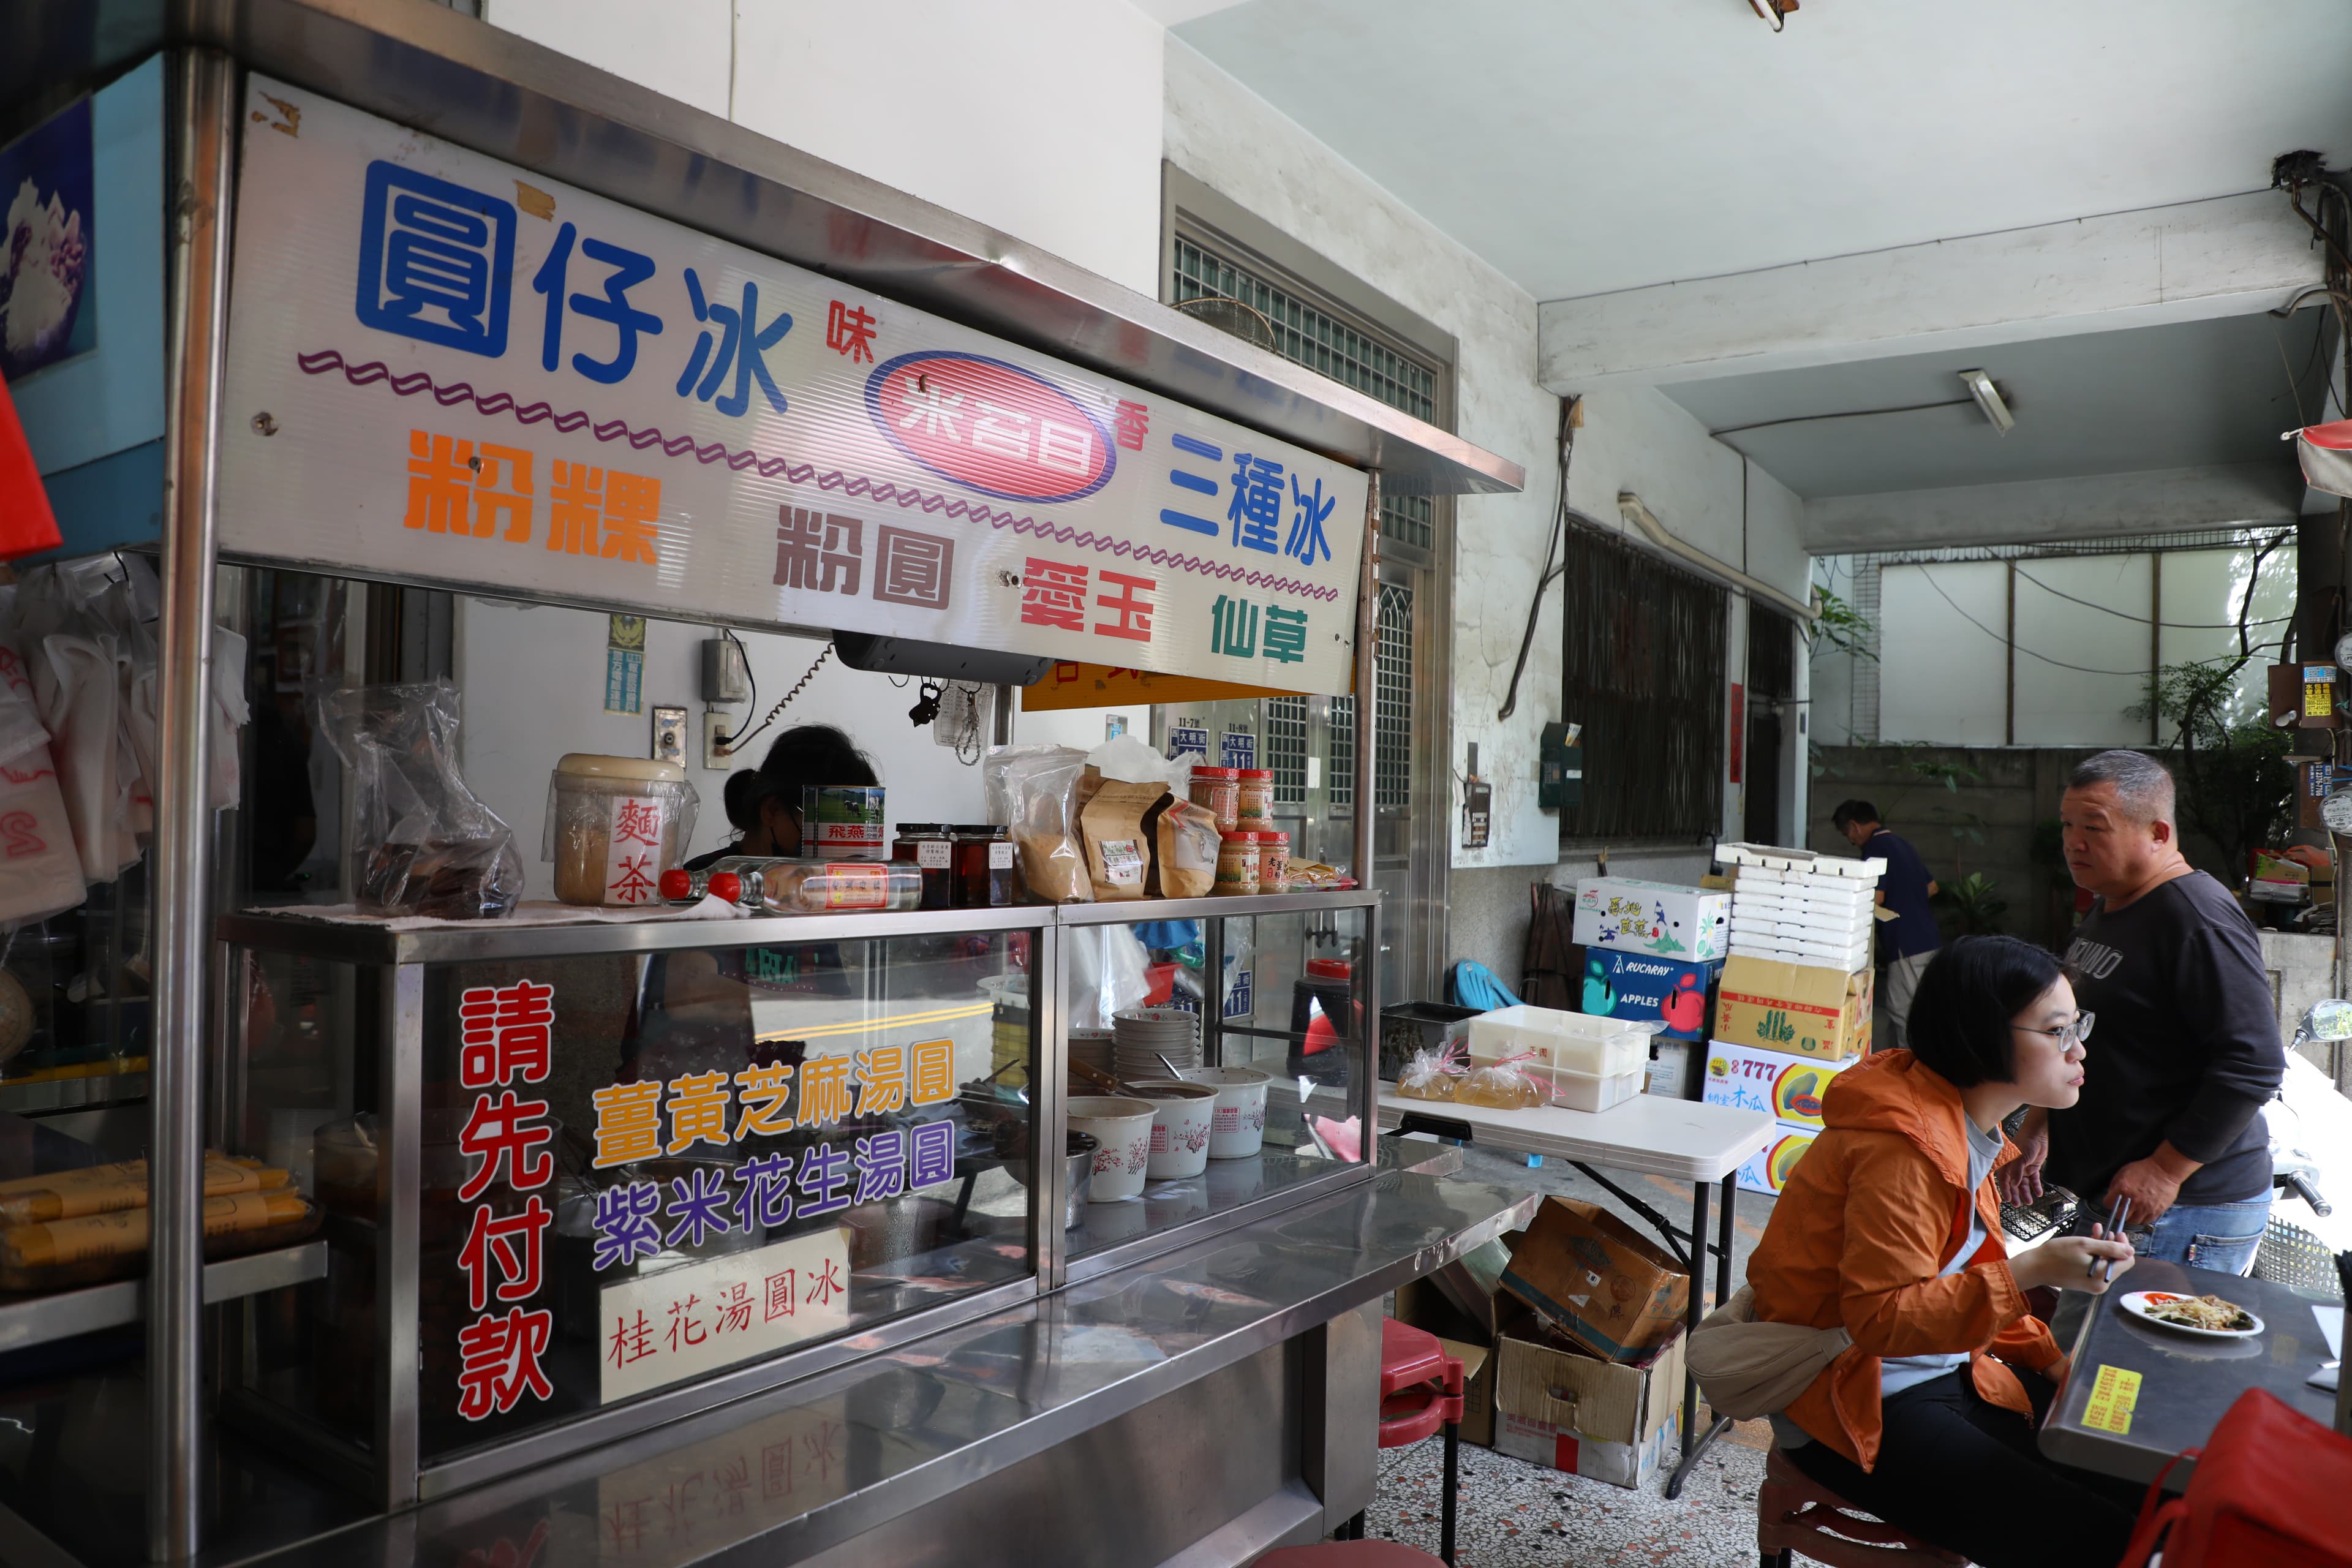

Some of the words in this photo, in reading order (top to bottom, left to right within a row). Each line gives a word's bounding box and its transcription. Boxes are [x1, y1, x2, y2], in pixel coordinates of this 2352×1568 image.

[355, 159, 794, 418] 圓仔冰
[826, 300, 877, 364] 味
[899, 379, 1098, 477] 米苔目
[1114, 399, 1149, 451] 香
[402, 429, 662, 566] 粉粿
[1159, 432, 1335, 566] 三種冰
[773, 503, 954, 610] 粉圓
[1020, 556, 1158, 643] 愛玉
[1210, 594, 1308, 663] 仙草
[1180, 731, 1206, 744] 大明街
[1229, 736, 1254, 750] 大明街
[608, 798, 660, 903] 麵茶
[829, 825, 864, 839] 飛燕
[1620, 993, 1659, 1008] APPLES
[1626, 962, 1670, 976] RUCARAY
[1720, 1001, 1733, 1032] 小黃瓜
[592, 1038, 956, 1169] 薑黃芝麻湯圓
[1743, 1059, 1777, 1082] 777
[458, 979, 555, 1421] 請先付款
[592, 1120, 956, 1272] 紫米花生湯圓
[606, 1256, 845, 1371] 桂花湯圓冰
